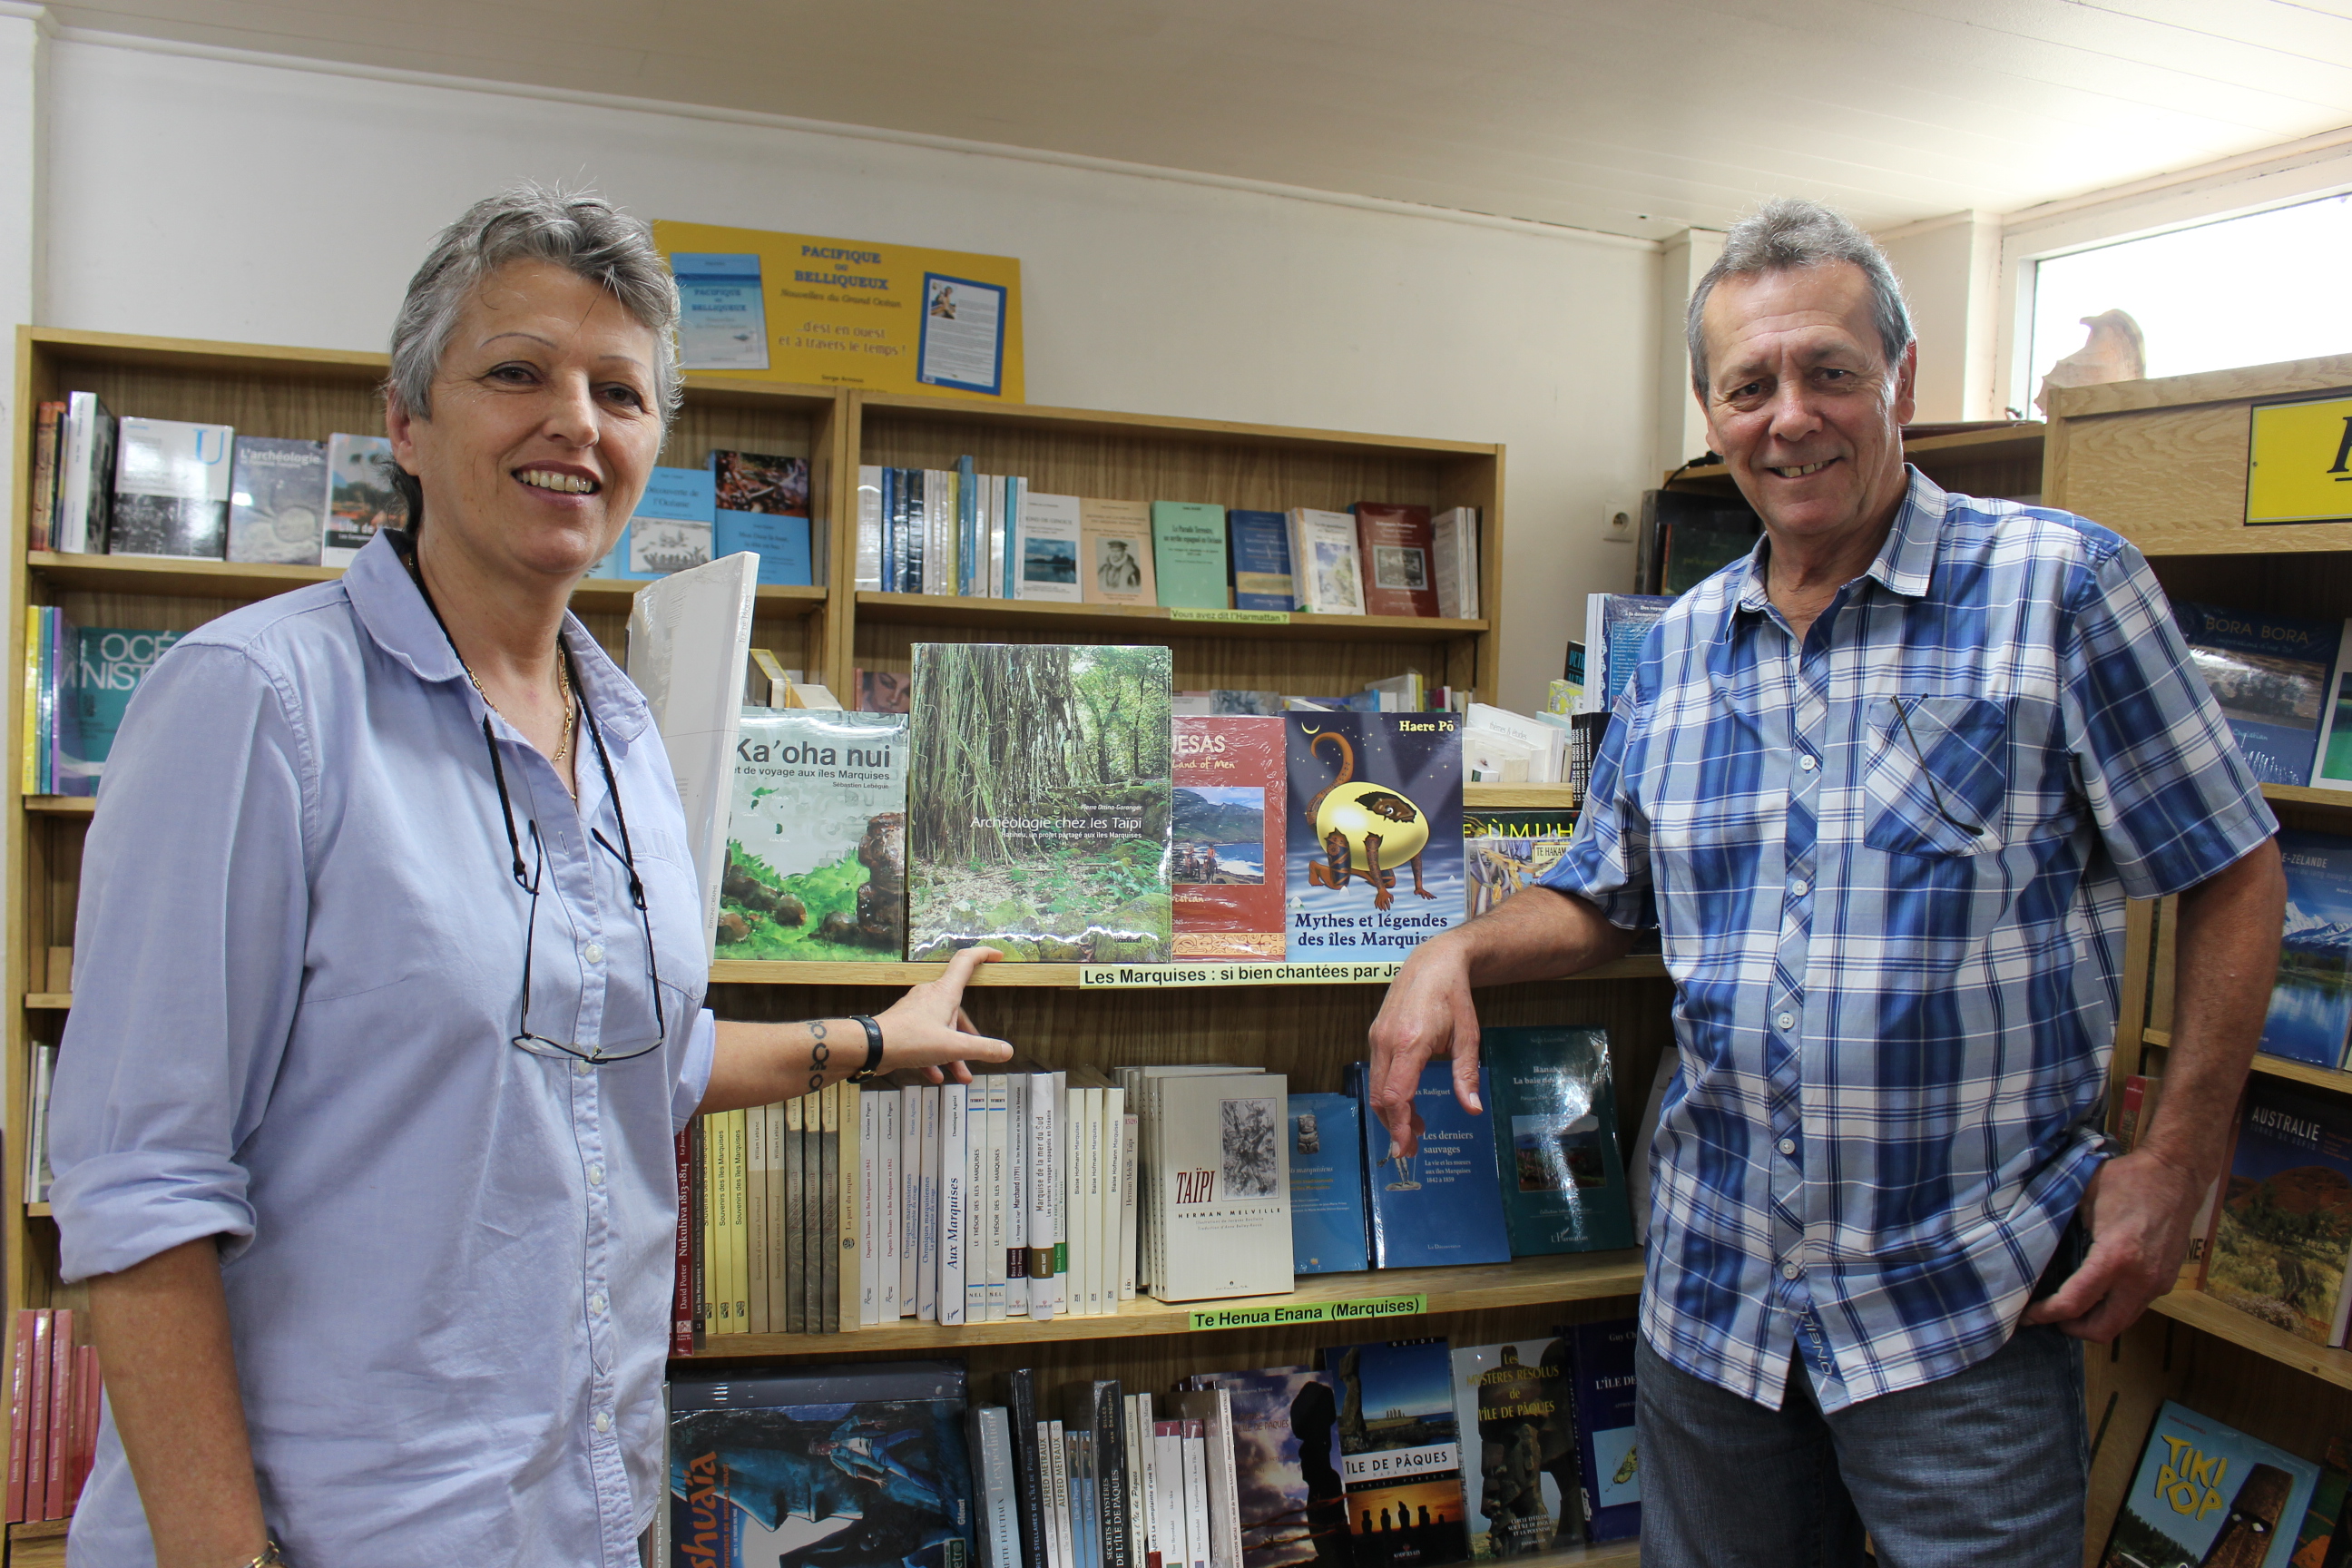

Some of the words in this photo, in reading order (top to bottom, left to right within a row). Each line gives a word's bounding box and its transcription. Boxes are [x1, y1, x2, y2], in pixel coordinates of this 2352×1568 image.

[801, 245, 881, 264] PACIFIQUE
[794, 270, 888, 289] BELLIQUEUX
[835, 326, 850, 336] en
[853, 327, 886, 338] ouest
[779, 336, 790, 346] et
[806, 338, 846, 350] travers
[849, 340, 859, 352] le
[864, 343, 898, 357] temps
[193, 428, 224, 466] U
[240, 448, 321, 466] L'archéologie
[1171, 610, 1193, 619] Vous
[1196, 612, 1215, 620] avez
[1218, 611, 1229, 620] dit
[1230, 612, 1280, 622] l'Harmattan
[2205, 616, 2252, 636] BORA
[2261, 625, 2309, 644] BORA
[1399, 720, 1436, 732] Haere
[848, 745, 890, 768] nui
[1171, 759, 1197, 769] Land
[1200, 756, 1211, 769] of
[1214, 760, 1235, 769] Men
[743, 766, 756, 775] de
[759, 768, 795, 779] voyage
[798, 769, 816, 778] aux
[818, 769, 835, 779] îles
[838, 770, 890, 780] Marquises
[970, 817, 1051, 832] Archéologie
[1055, 817, 1086, 828] chez
[1090, 817, 1108, 828] les
[1112, 818, 1142, 831] Taïpi
[1536, 847, 1544, 856] TE
[1295, 913, 1354, 930] Mythes
[1358, 916, 1373, 927] et
[1378, 913, 1448, 930] légendes
[1298, 932, 1324, 946] des
[1328, 932, 1356, 946] îles
[1084, 970, 1114, 985] Les
[1120, 968, 1206, 986] Marquises
[1220, 966, 1233, 981] si
[1239, 965, 1273, 980] bien
[1276, 965, 1348, 979] chantées
[1353, 966, 1380, 981] par
[1423, 1088, 1451, 1097] Radiguet
[1035, 1116, 1044, 1130] Sud
[2251, 1106, 2320, 1141] AUSTRALIE
[1036, 1132, 1044, 1141] du
[1423, 1131, 1437, 1140] Les
[1438, 1131, 1474, 1140] derniers
[718, 1131, 726, 1164] Marquises
[1424, 1147, 1461, 1156] sauvages
[1125, 1159, 1133, 1181] Melville
[680, 1162, 689, 1204] 1813-1814
[1176, 1168, 1215, 1204] TAÏPI
[845, 1195, 852, 1203] du
[1035, 1179, 1045, 1211] Marquise
[946, 1178, 961, 1241] Marquises
[1178, 1211, 1221, 1220] HERMAN
[1230, 1208, 1280, 1216] MELVILLE
[680, 1207, 688, 1256] Nukuhiva
[845, 1221, 852, 1230] La
[946, 1245, 958, 1269] Aux
[1195, 1313, 1214, 1328] Te
[1220, 1310, 1270, 1326] Henua
[1275, 1308, 1323, 1321] Enana
[1330, 1298, 1420, 1321] (Marquises)
[1504, 1354, 1518, 1365] Les
[1466, 1369, 1514, 1387] MYSTÈRES
[1595, 1376, 1622, 1390] L'ÎLE
[1509, 1387, 1521, 1399] de
[1501, 1406, 1514, 1418] DE
[1517, 1400, 1555, 1417] PÂQUES
[1345, 1461, 1366, 1475] ÎLE
[1372, 1459, 1389, 1471] DE
[1396, 1451, 1447, 1468] PÂQUES
[2161, 1434, 2228, 1488] TIKI
[1102, 1478, 1111, 1517] MYSTÈRES
[1112, 1470, 1121, 1508] PÂQUES
[2154, 1464, 2223, 1522] POP
[957, 1498, 965, 1525] Glénat
[1148, 1491, 1156, 1524] complainte
[1113, 1511, 1122, 1524] DE
[1113, 1527, 1122, 1551] L'ÎLE
[1116, 1553, 1124, 1566] DE
